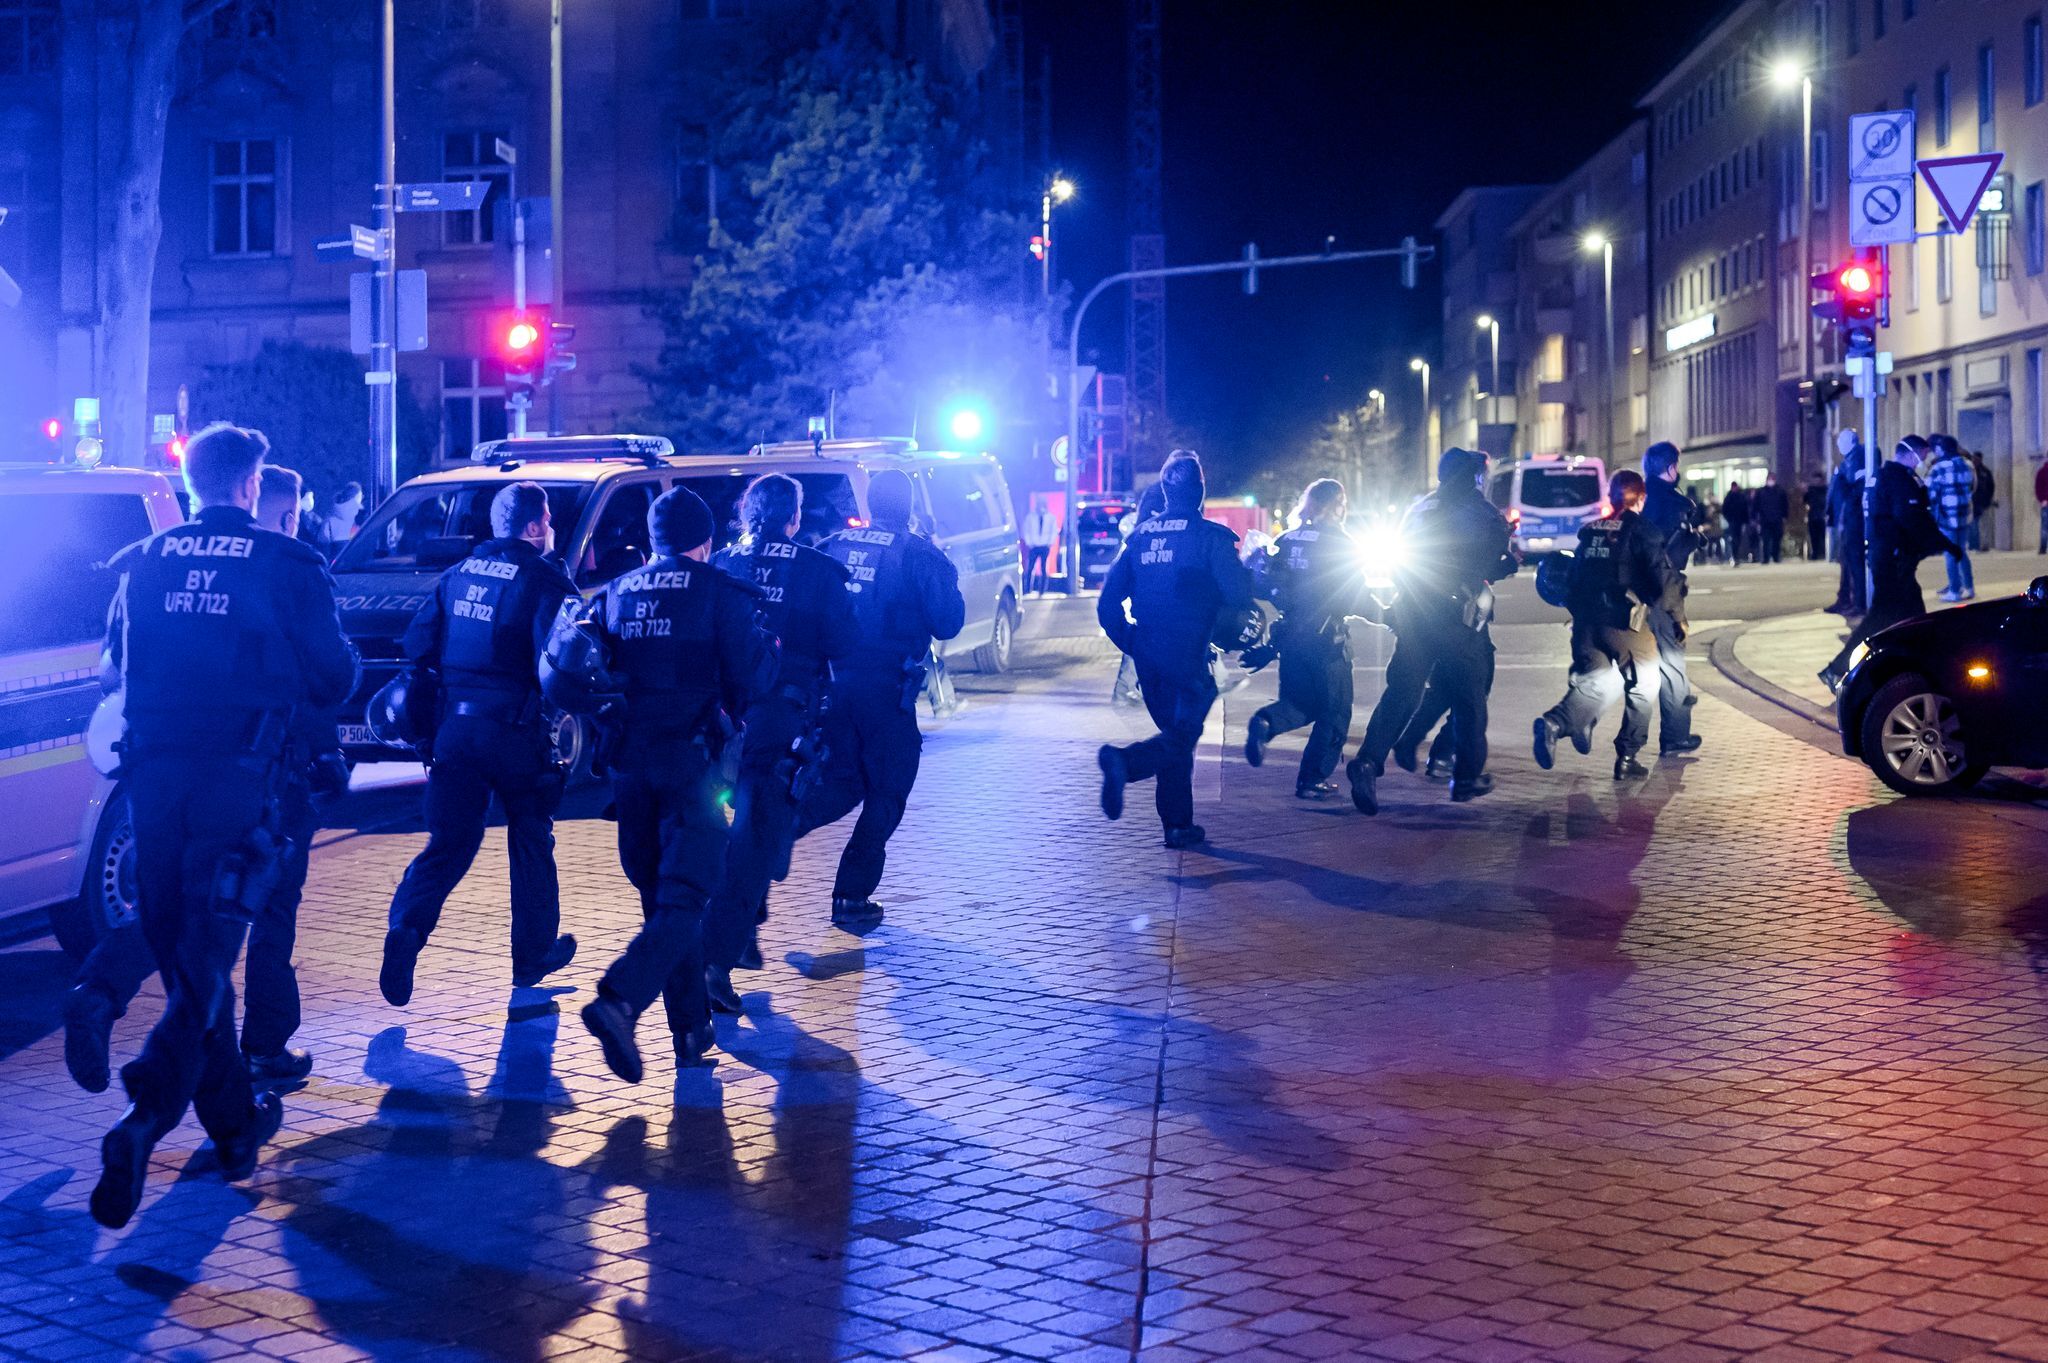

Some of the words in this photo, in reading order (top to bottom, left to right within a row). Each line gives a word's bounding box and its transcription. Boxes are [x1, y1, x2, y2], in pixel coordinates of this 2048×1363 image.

[1140, 519, 1188, 534] POLIZEI
[838, 528, 895, 546] POLIZEI
[1150, 538, 1167, 551] BY
[161, 535, 254, 558] POLIZEI
[729, 542, 798, 559] POIZEI
[847, 550, 869, 566] BY
[460, 559, 519, 580] POLIZEI
[185, 569, 218, 591] BY
[618, 571, 691, 595] POLIZEI
[466, 584, 488, 602] BY
[165, 592, 194, 613] UFR
[197, 593, 229, 615] 7122
[334, 595, 429, 611] POLIZEI
[471, 603, 493, 621] 7122
[635, 600, 659, 618] BY
[621, 621, 642, 640] UFR
[646, 618, 671, 636] 7122
